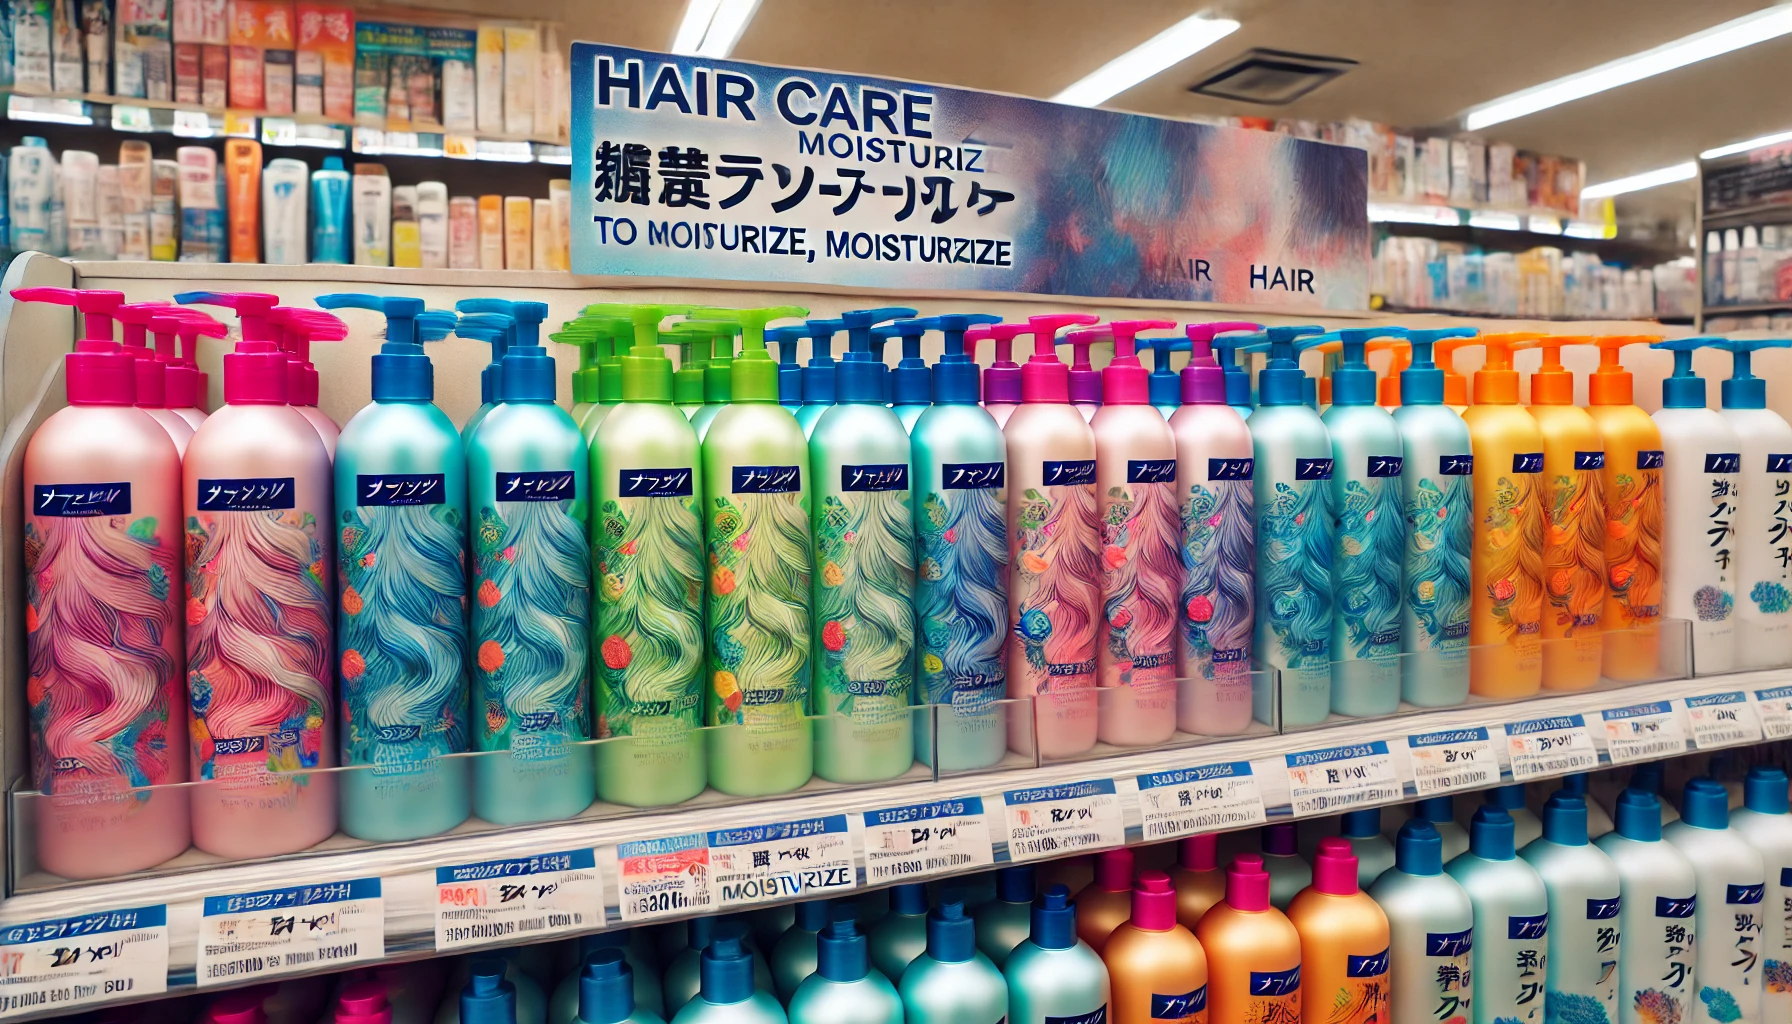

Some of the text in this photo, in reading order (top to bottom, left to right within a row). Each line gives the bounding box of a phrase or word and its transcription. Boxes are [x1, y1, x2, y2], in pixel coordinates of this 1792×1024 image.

[598, 58, 933, 139] HAIR CARE
[799, 131, 985, 173] MOISTURIZ
[593, 216, 637, 246] TO
[1250, 264, 1315, 294] HAIR
